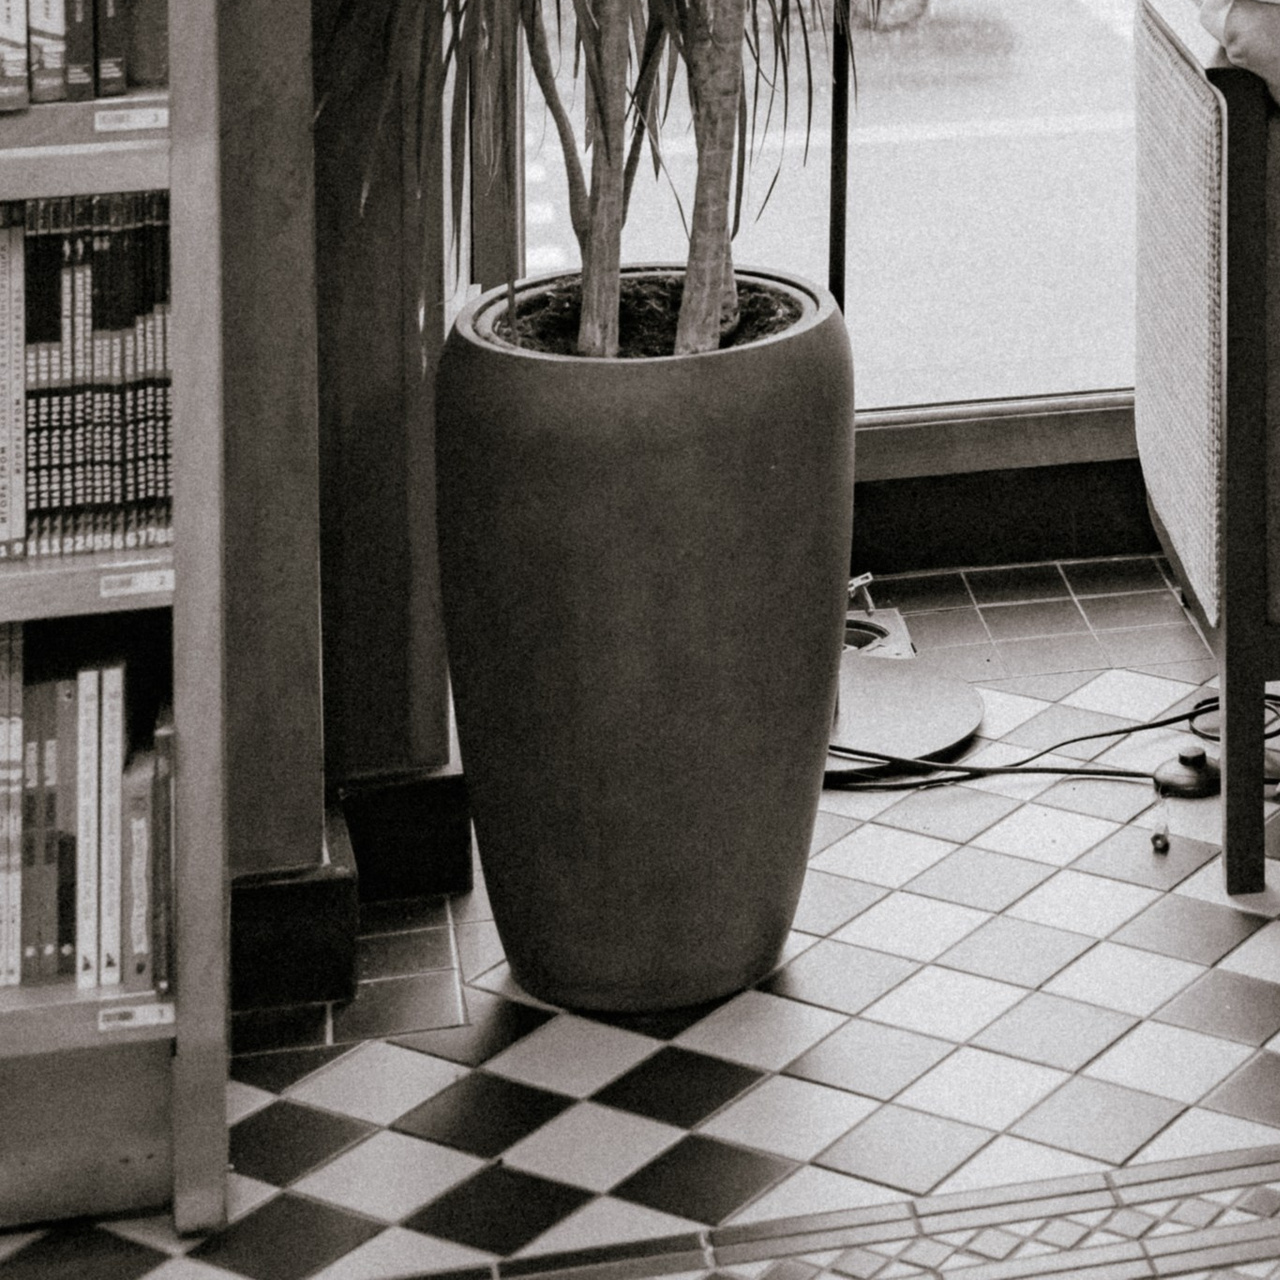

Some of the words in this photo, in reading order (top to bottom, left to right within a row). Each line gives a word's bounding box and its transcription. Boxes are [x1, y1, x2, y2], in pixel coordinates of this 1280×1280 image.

[27, 399, 36, 429] ГРОМ
[39, 397, 49, 427] ГРОМ
[51, 396, 60, 426] ГРОМ
[63, 396, 72, 426] ГРОМ
[75, 394, 84, 424] ГРОМ
[94, 393, 102, 423] ГРОМ
[103, 392, 111, 422] ГРОМ
[113, 394, 122, 423] ГРОМ
[126, 391, 135, 421] ГРОМ
[137, 389, 145, 419] ГРОМ
[156, 387, 164, 417] ГРОМ
[27, 432, 36, 467] ИГОРЬ
[39, 430, 49, 466] ИГОРЬ
[51, 429, 60, 465] ИГОРЬ
[63, 428, 72, 464] ИГОРЬ
[75, 426, 84, 462] ИГОРЬ
[94, 426, 102, 461] ИГОРЬ
[103, 425, 111, 461] ИГОРЬ
[113, 426, 122, 462] ИГОРЬ
[126, 424, 135, 459] ИГОРЬ
[137, 422, 145, 457] ИГОРЬ
[156, 420, 164, 455] ИГОРЬ
[27, 540, 37, 556] 1
[40, 538, 50, 555] 1
[51, 538, 61, 553] 1
[63, 537, 74, 553] 2
[75, 535, 85, 551] 2
